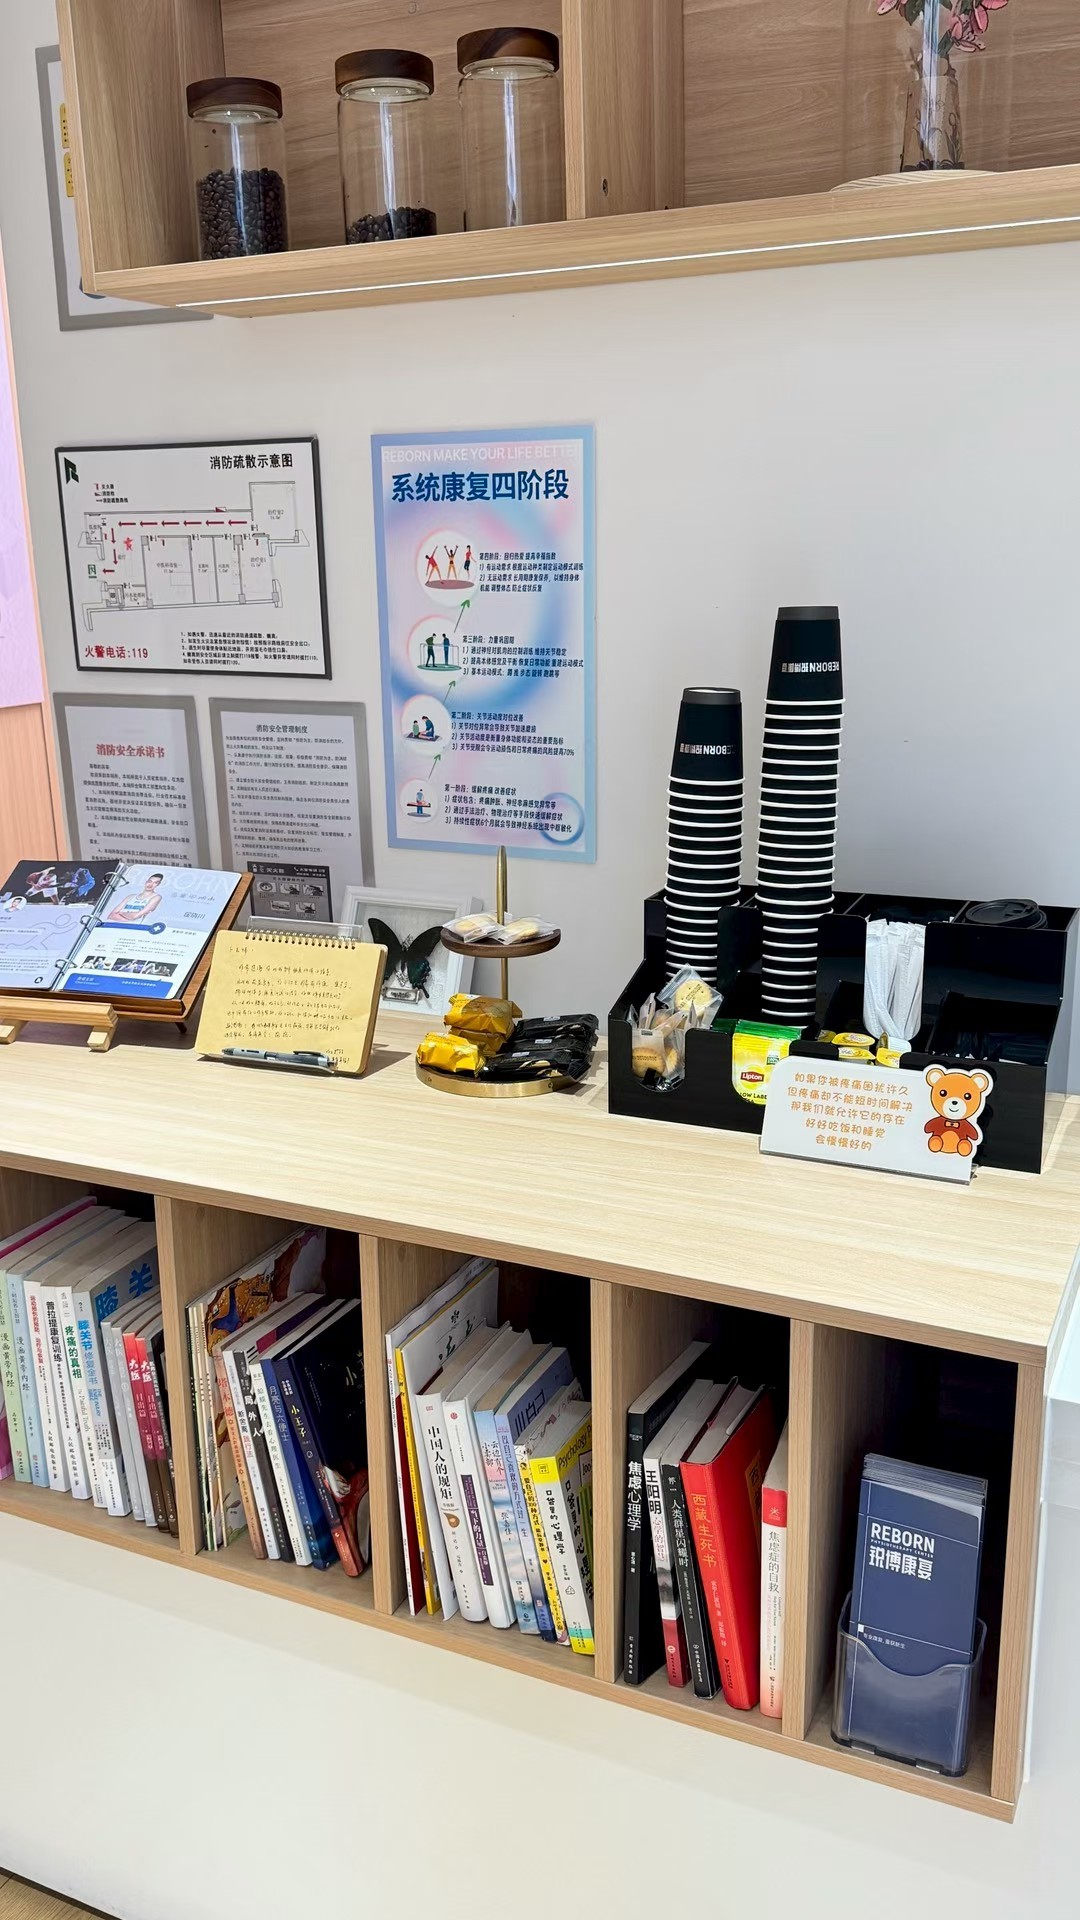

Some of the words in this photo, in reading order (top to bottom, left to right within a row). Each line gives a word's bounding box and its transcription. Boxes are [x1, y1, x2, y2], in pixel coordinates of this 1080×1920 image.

[210, 453, 293, 470] 消防疏散示意图
[383, 449, 431, 463] REBORN
[433, 448, 468, 462] MAKE
[470, 447, 505, 460] YOUR
[506, 446, 531, 459] LIFE
[391, 468, 569, 502] 系统康复四阶段
[85, 645, 149, 659] 火警电话:119
[809, 660, 840, 673] REBORN
[256, 724, 308, 734] 消防安全管理制度
[96, 743, 165, 759] 消防安全承诺书
[703, 743, 737, 755] EBORN
[742, 1072, 763, 1081] Lipton
[794, 1072, 909, 1096] 如果你被疼痛困扰许久
[787, 1086, 913, 1113] 但疼痛却不能短时间解决
[791, 1100, 905, 1126] 那我们就允许它的存在
[805, 1117, 886, 1139] 好好吃饭和睡觉
[815, 1134, 872, 1151] 会慢慢好的
[46, 1301, 62, 1363] 普拉提康复训练
[65, 1325, 82, 1379] 疼痛的真相
[78, 1320, 98, 1385] 膝关节修复全书
[78, 1394, 88, 1416] Painful
[218, 1378, 233, 1417] 塔木德
[269, 1386, 290, 1442] 月亮与六便士
[82, 1415, 91, 1432] Truth
[244, 1395, 261, 1437] 局外人
[291, 1405, 307, 1437] 小王子
[428, 1426, 453, 1499] 中国人的规矩
[482, 1442, 494, 1467] 小卖部
[491, 1440, 505, 1475] 云边有个
[559, 1432, 588, 1468] Psychology
[502, 1435, 528, 1538] 以自己喜欢的方式过一生
[627, 1461, 642, 1531] 焦虑心理学
[646, 1470, 662, 1515] 王阳明
[470, 1509, 484, 1547] 当下的力量
[545, 1489, 566, 1555] 口袋里的心理学
[671, 1499, 689, 1567] 人类群星闪耀时
[691, 1493, 717, 1568] 西藏生死书
[870, 1522, 935, 1554] REBORN
[768, 1531, 780, 1593] 焦虑症的自救
[868, 1545, 934, 1581] 锐博康复
[870, 1539, 912, 1553] PHYSIOTHERAPY
[914, 1549, 934, 1558] CENTER
